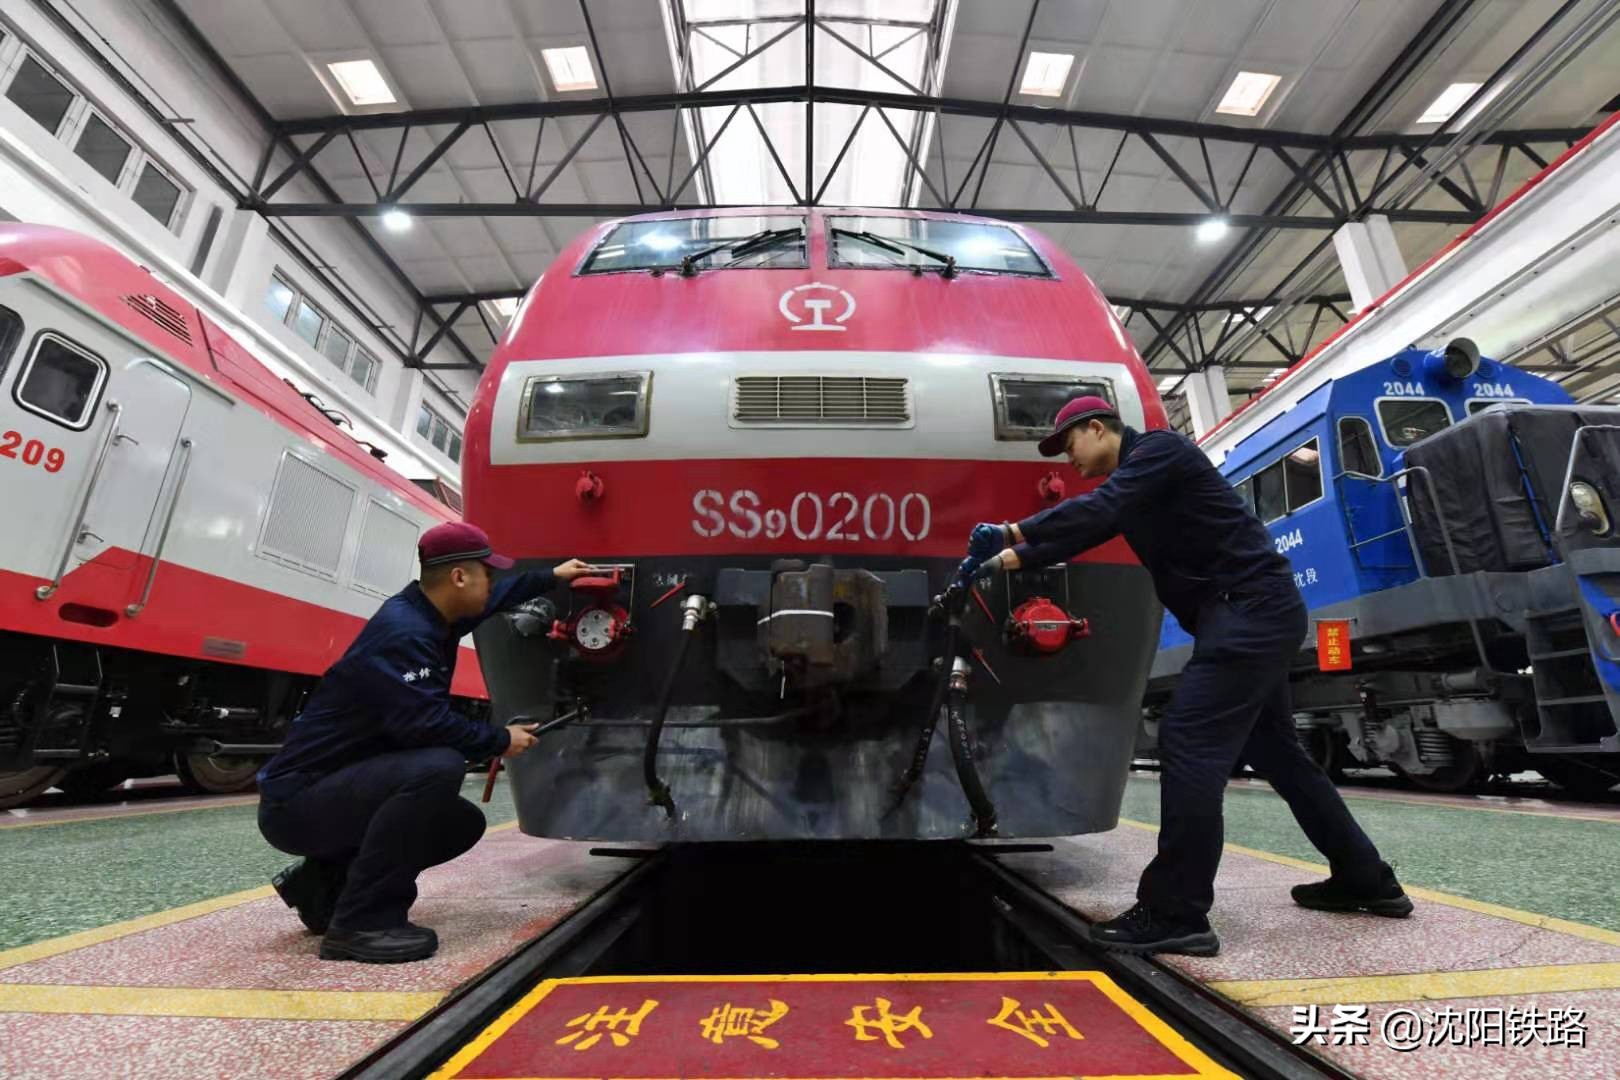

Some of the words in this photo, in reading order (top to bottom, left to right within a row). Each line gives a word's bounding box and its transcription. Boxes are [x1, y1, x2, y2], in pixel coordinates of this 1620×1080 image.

[1383, 381, 1425, 396] 2044
[1473, 383, 1515, 397] 2044
[0, 430, 65, 473] 209
[1275, 528, 1303, 554] 2044
[555, 997, 1085, 1050] 注意安全
